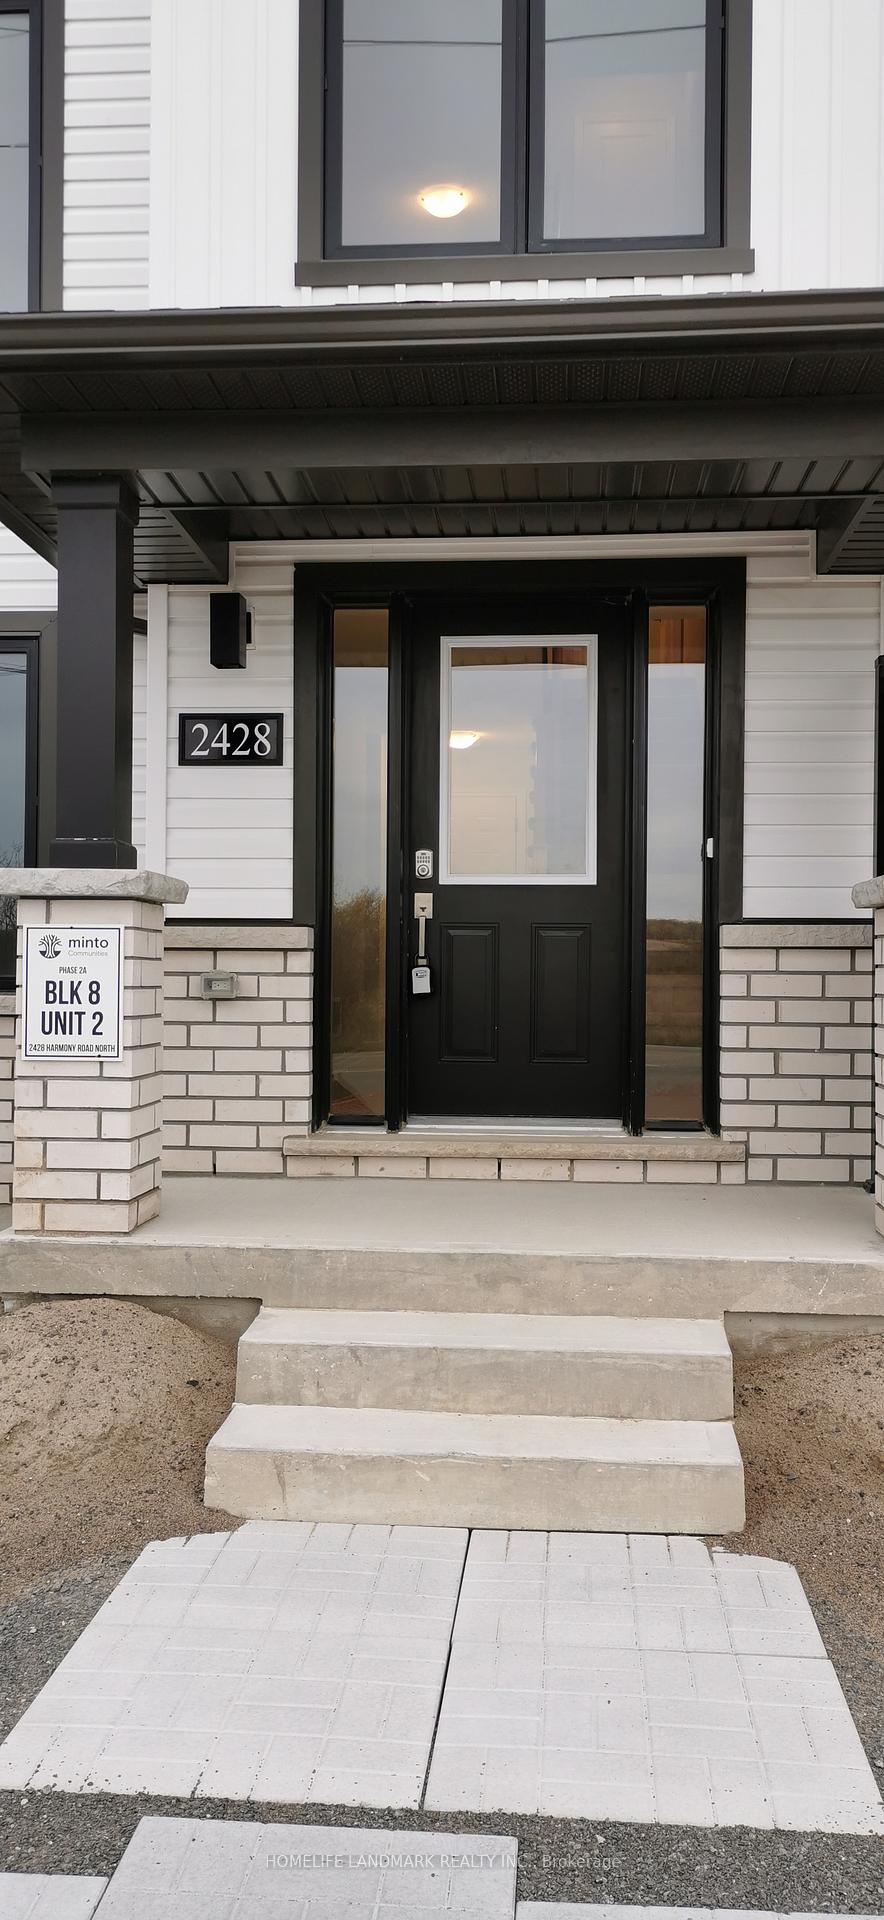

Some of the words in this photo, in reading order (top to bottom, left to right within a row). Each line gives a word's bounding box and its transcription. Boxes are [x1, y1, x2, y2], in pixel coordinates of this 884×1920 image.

[190, 722, 271, 756] 2428
[68, 936, 109, 948] minto
[58, 966, 78, 974] PHASE
[79, 966, 87, 974] 2A
[45, 980, 82, 1005] BLK
[88, 980, 101, 1005] 8
[41, 1011, 86, 1036] UNIT
[91, 1011, 104, 1036] 2
[29, 1043, 45, 1052] 2428
[46, 1043, 76, 1052] HARMONY
[77, 1044, 94, 1053] ROAD
[95, 1044, 116, 1053] NORTH
